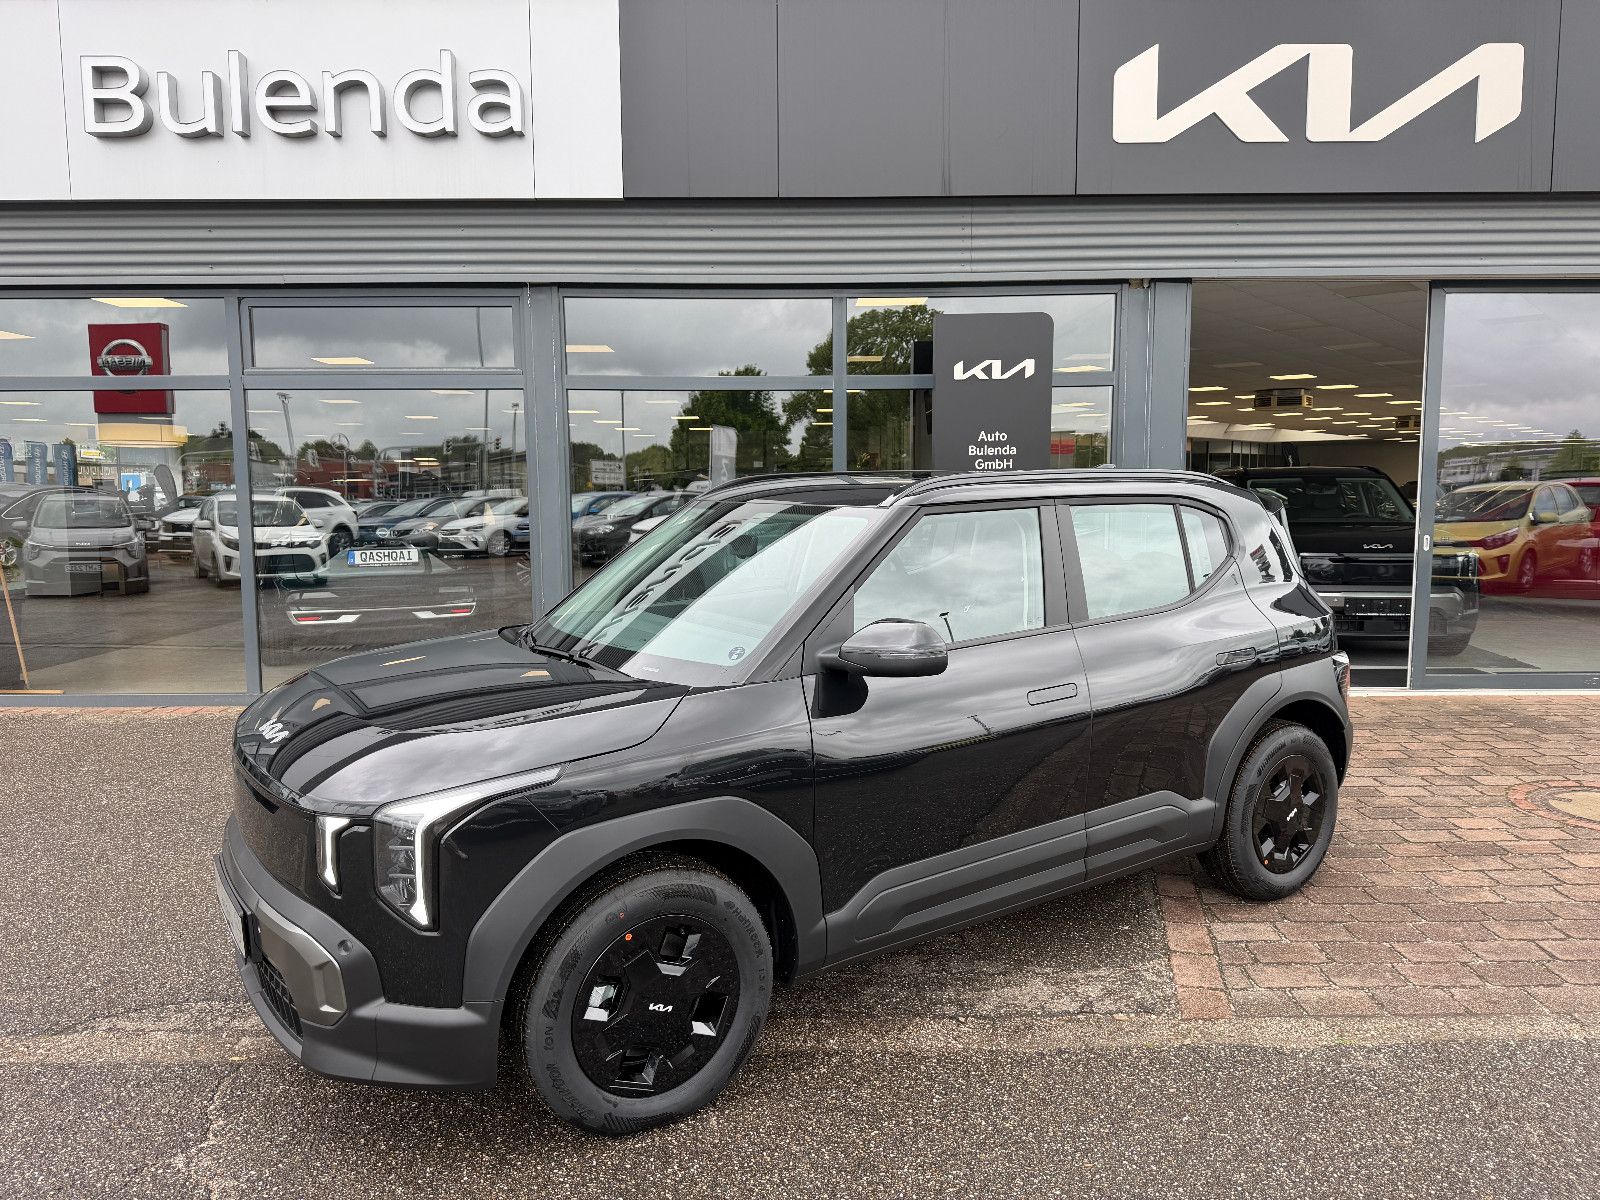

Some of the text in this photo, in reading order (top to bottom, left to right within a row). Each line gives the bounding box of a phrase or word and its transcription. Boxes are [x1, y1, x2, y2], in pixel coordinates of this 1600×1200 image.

[79, 48, 526, 138] Bulenda
[1112, 42, 1525, 143] KIA
[953, 358, 1036, 381] KIA
[977, 430, 1008, 442] Auto
[968, 444, 1017, 456] Bulenda
[974, 458, 1013, 470] GmbH
[359, 551, 413, 562] QASHQAI
